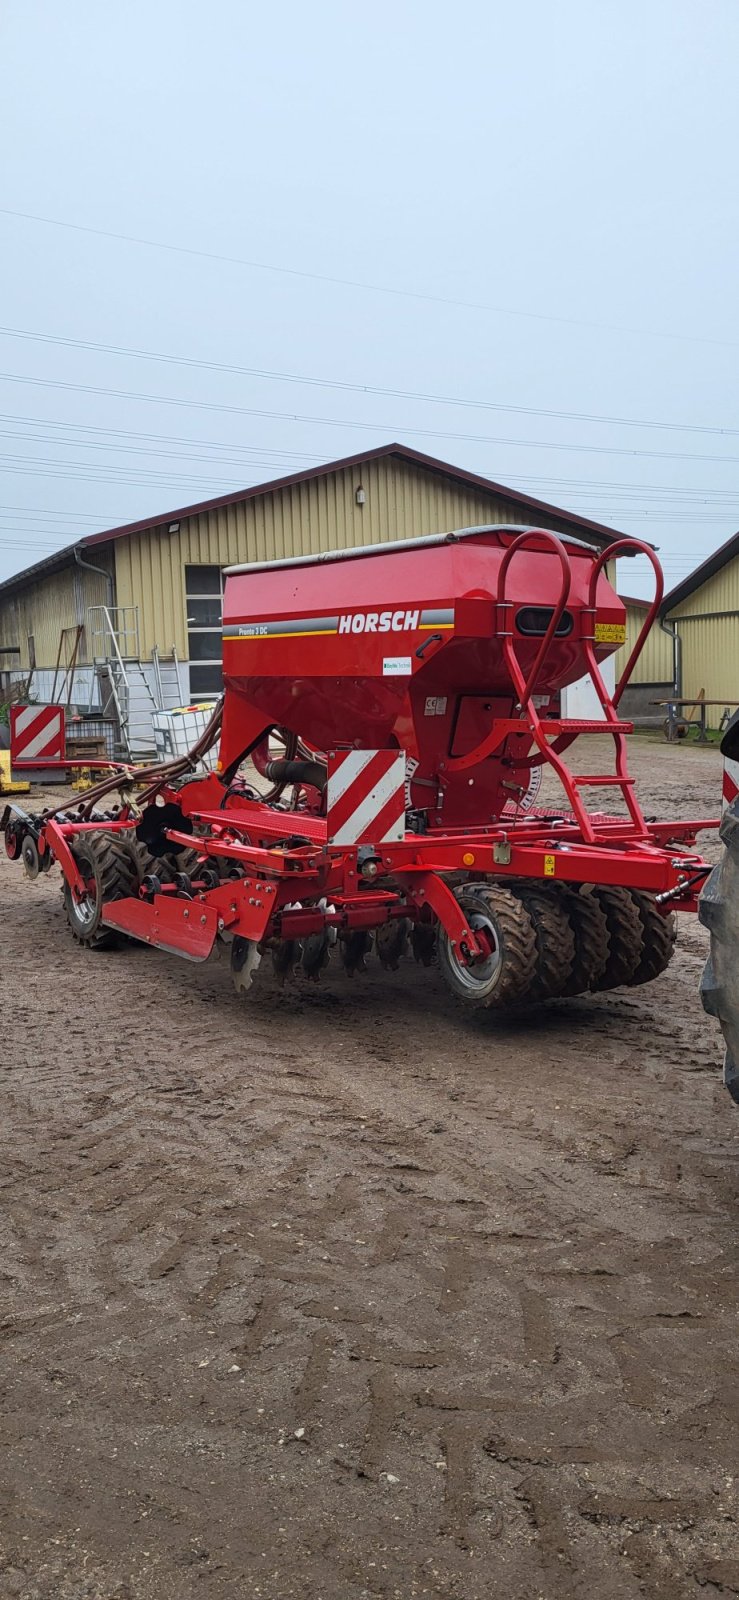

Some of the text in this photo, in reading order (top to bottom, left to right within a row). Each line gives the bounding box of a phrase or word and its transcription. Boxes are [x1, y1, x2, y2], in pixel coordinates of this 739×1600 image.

[338, 610, 420, 634] HORSCH
[255, 627, 259, 635] 3
[259, 626, 268, 635] DC
